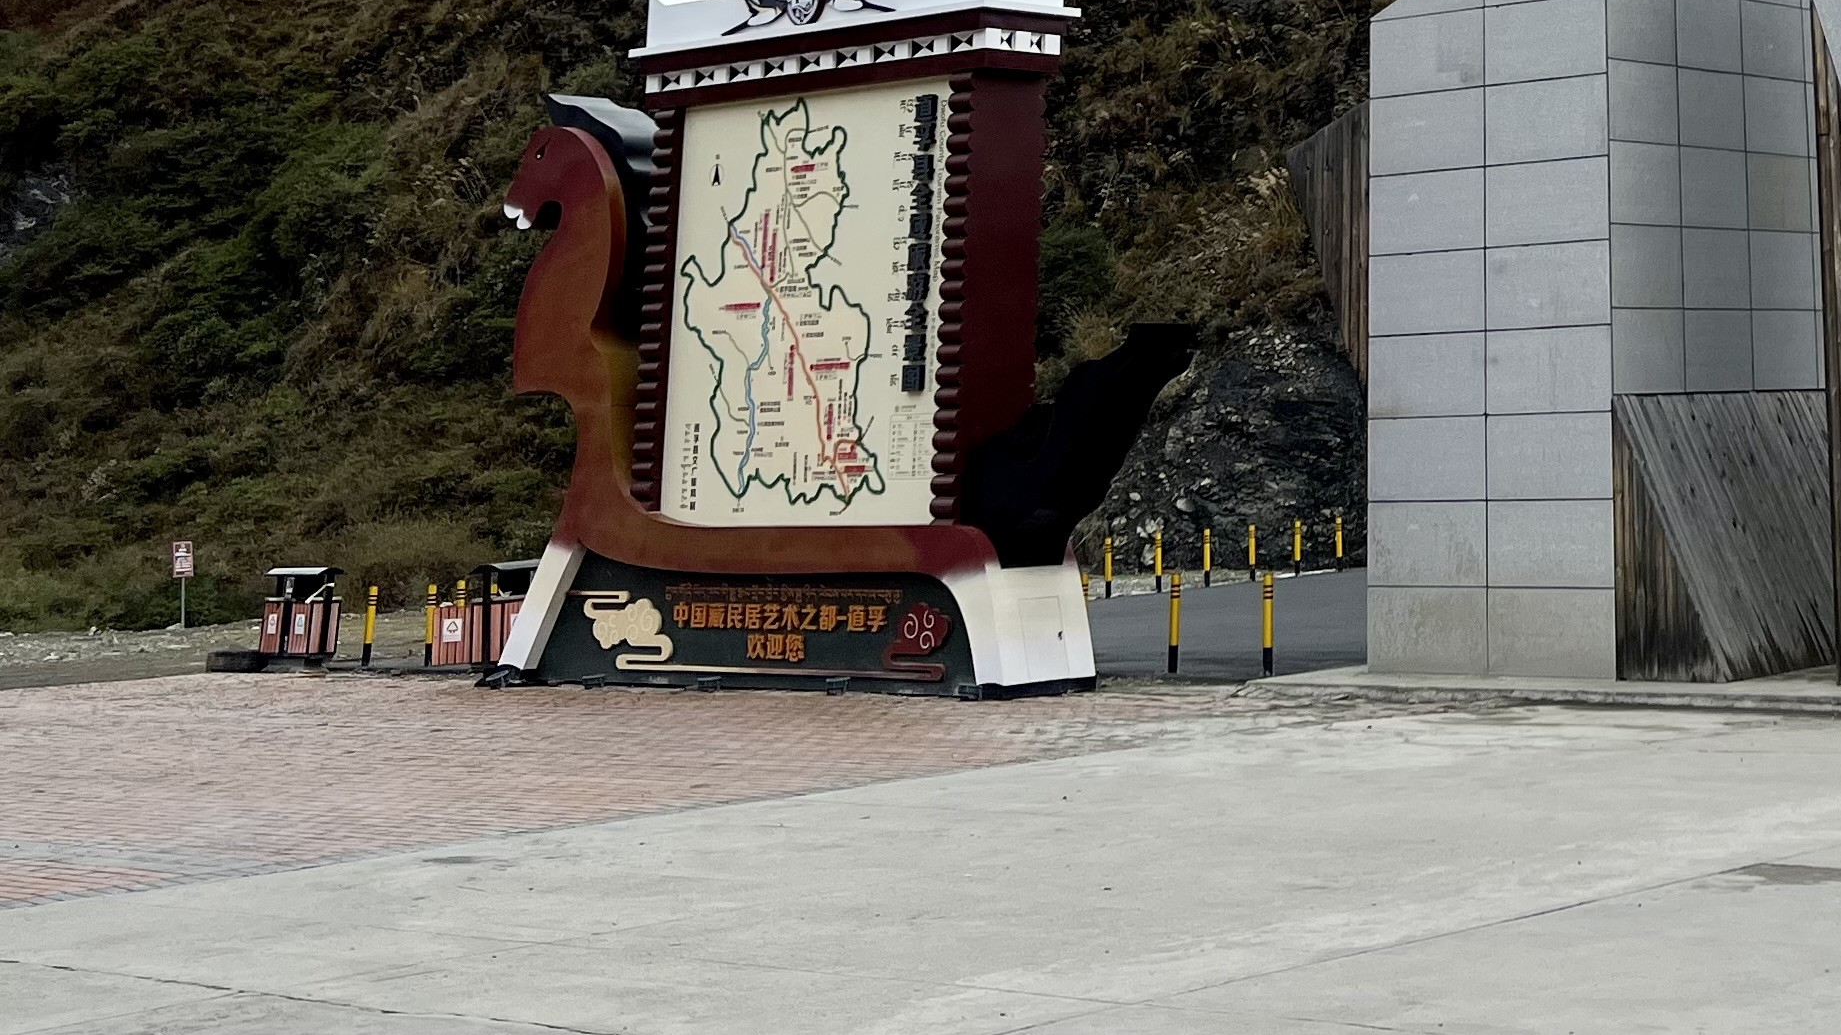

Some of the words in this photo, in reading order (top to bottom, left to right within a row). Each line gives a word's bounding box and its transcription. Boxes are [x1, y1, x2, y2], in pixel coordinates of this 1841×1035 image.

[937, 130, 946, 163] County
[746, 633, 806, 662] 欢迎您
